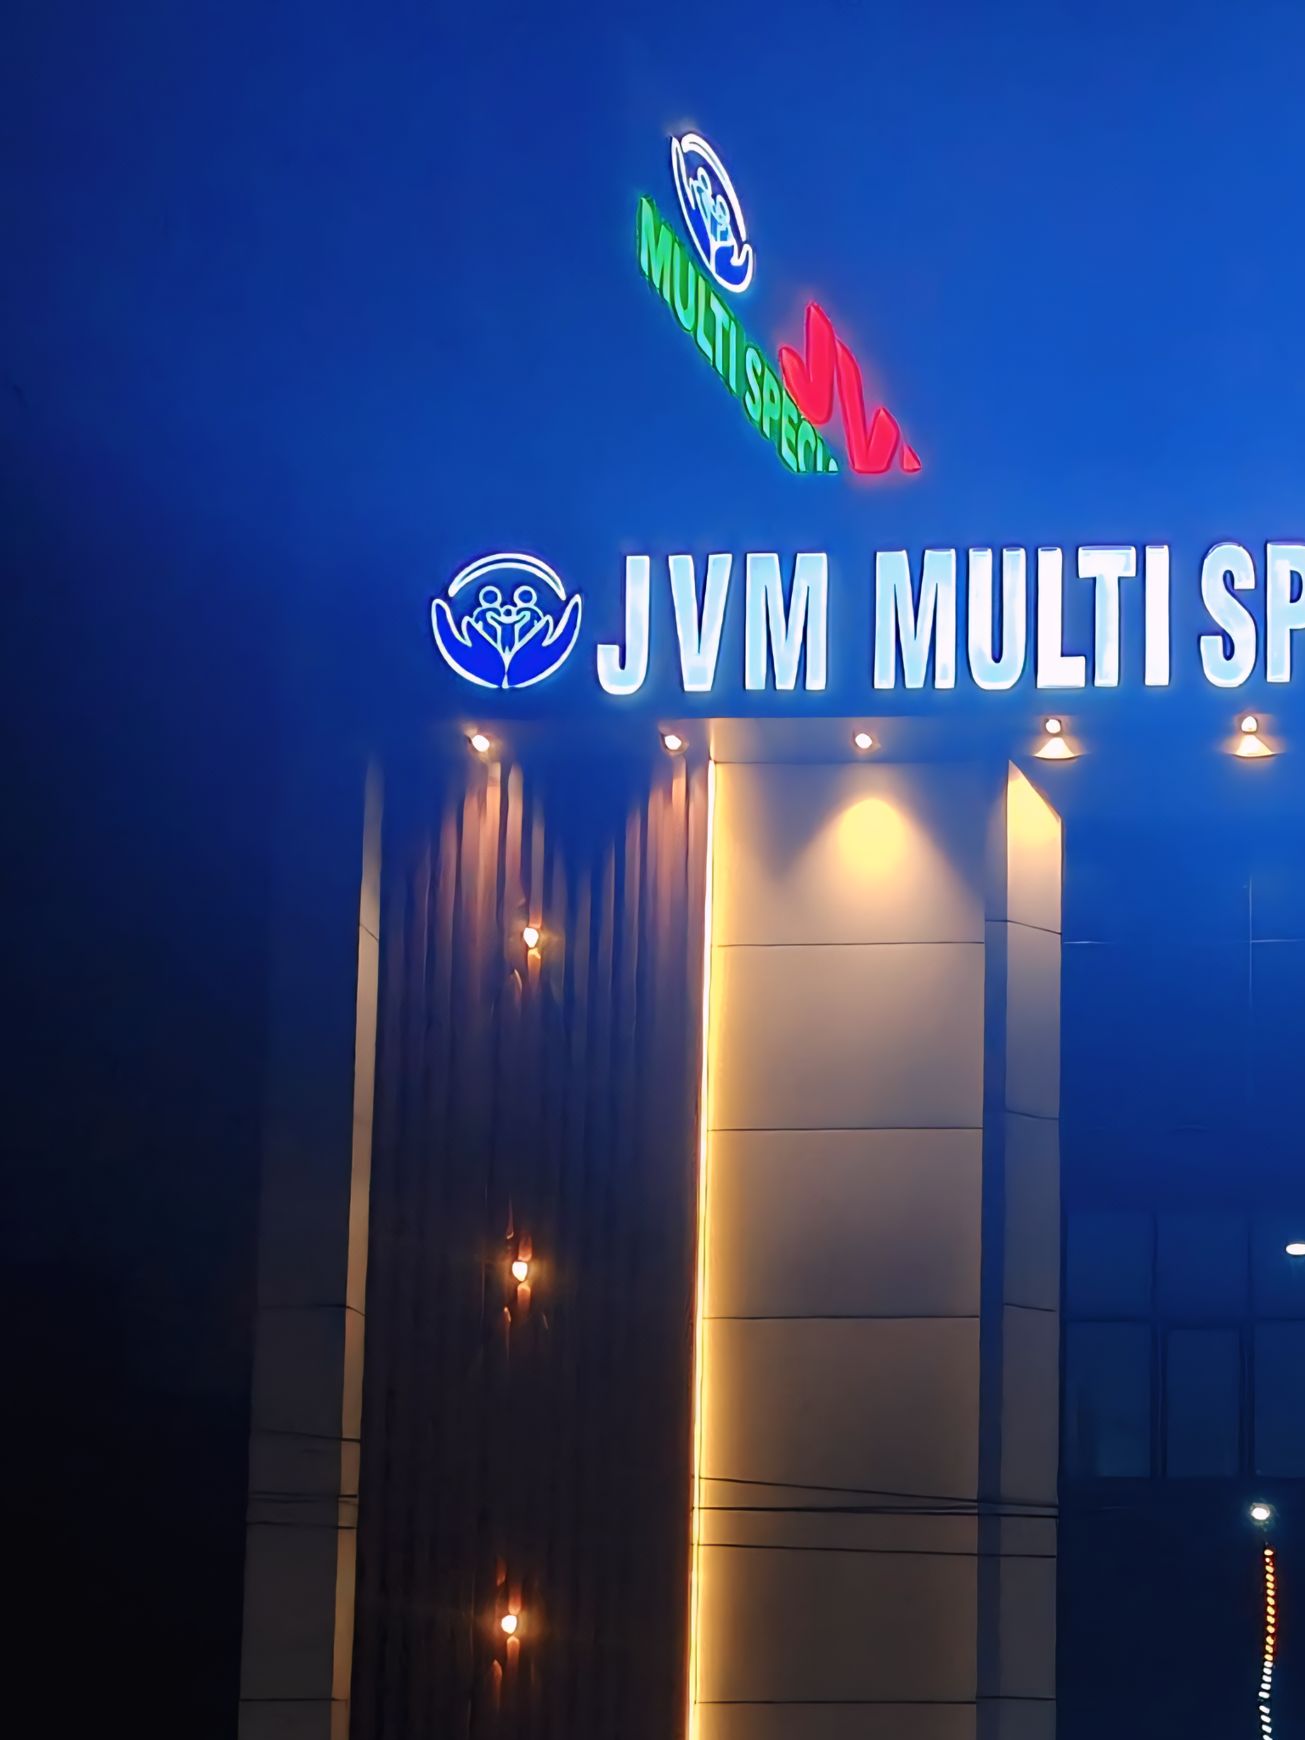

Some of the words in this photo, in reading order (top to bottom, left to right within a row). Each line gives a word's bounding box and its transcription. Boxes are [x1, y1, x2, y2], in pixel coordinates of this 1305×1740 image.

[637, 194, 739, 396] MULTI
[597, 552, 829, 696] JVM
[873, 545, 1171, 690] MULTI
